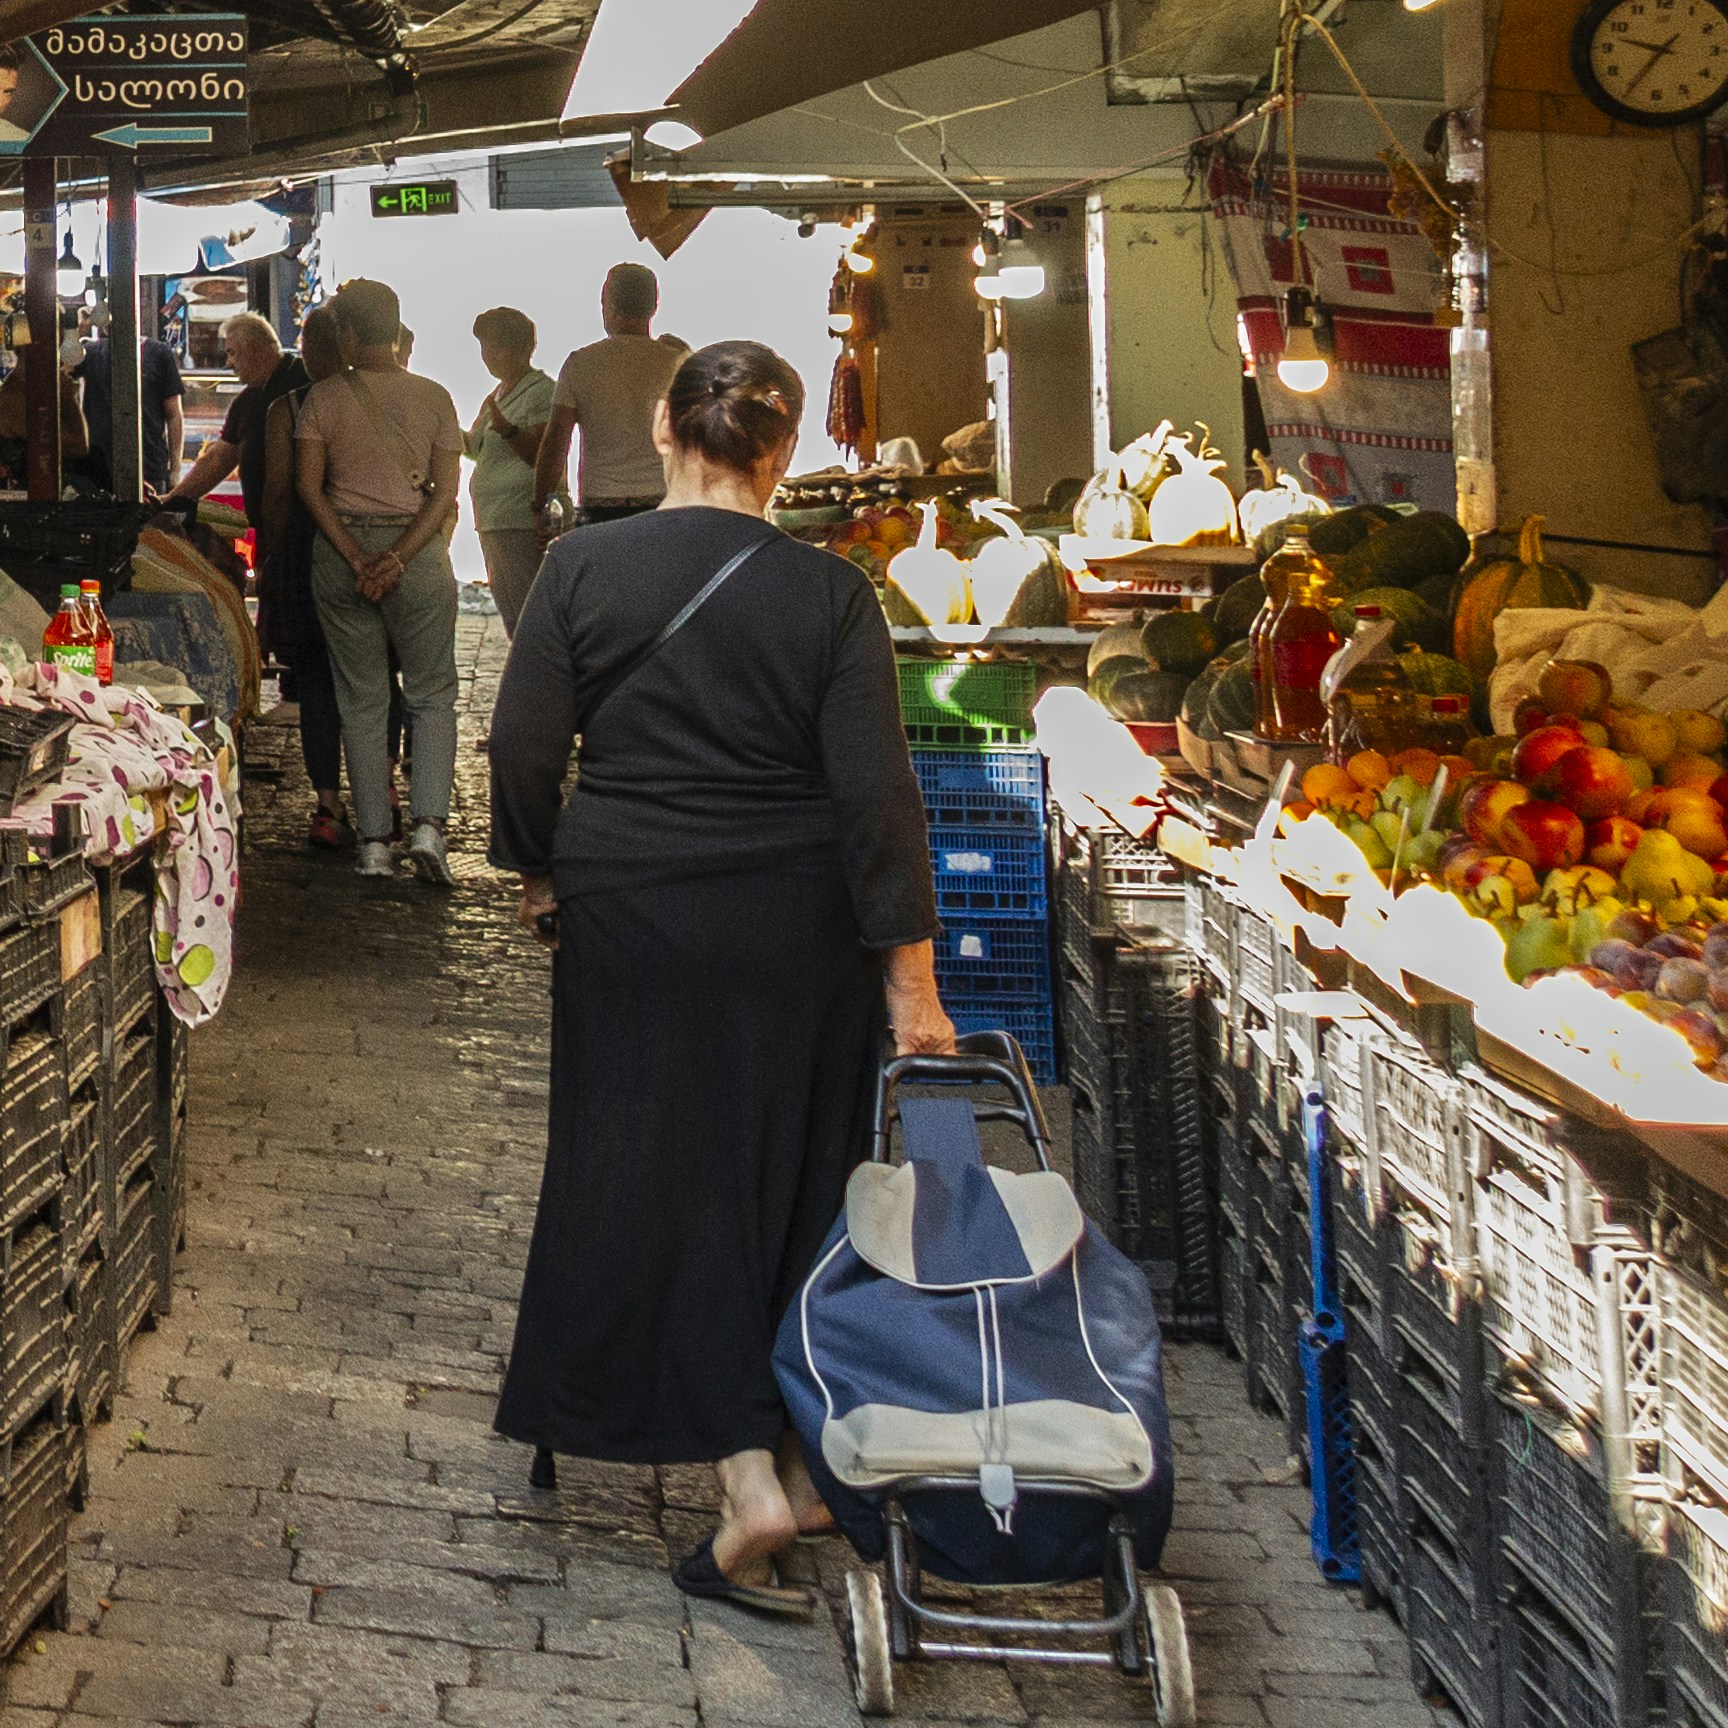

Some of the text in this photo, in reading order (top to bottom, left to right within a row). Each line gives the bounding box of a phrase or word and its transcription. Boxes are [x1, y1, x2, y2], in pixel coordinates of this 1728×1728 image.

[47, 27, 245, 60] მამაკაცთა
[75, 72, 245, 108] სალონი
[428, 192, 451, 204] EXIT
